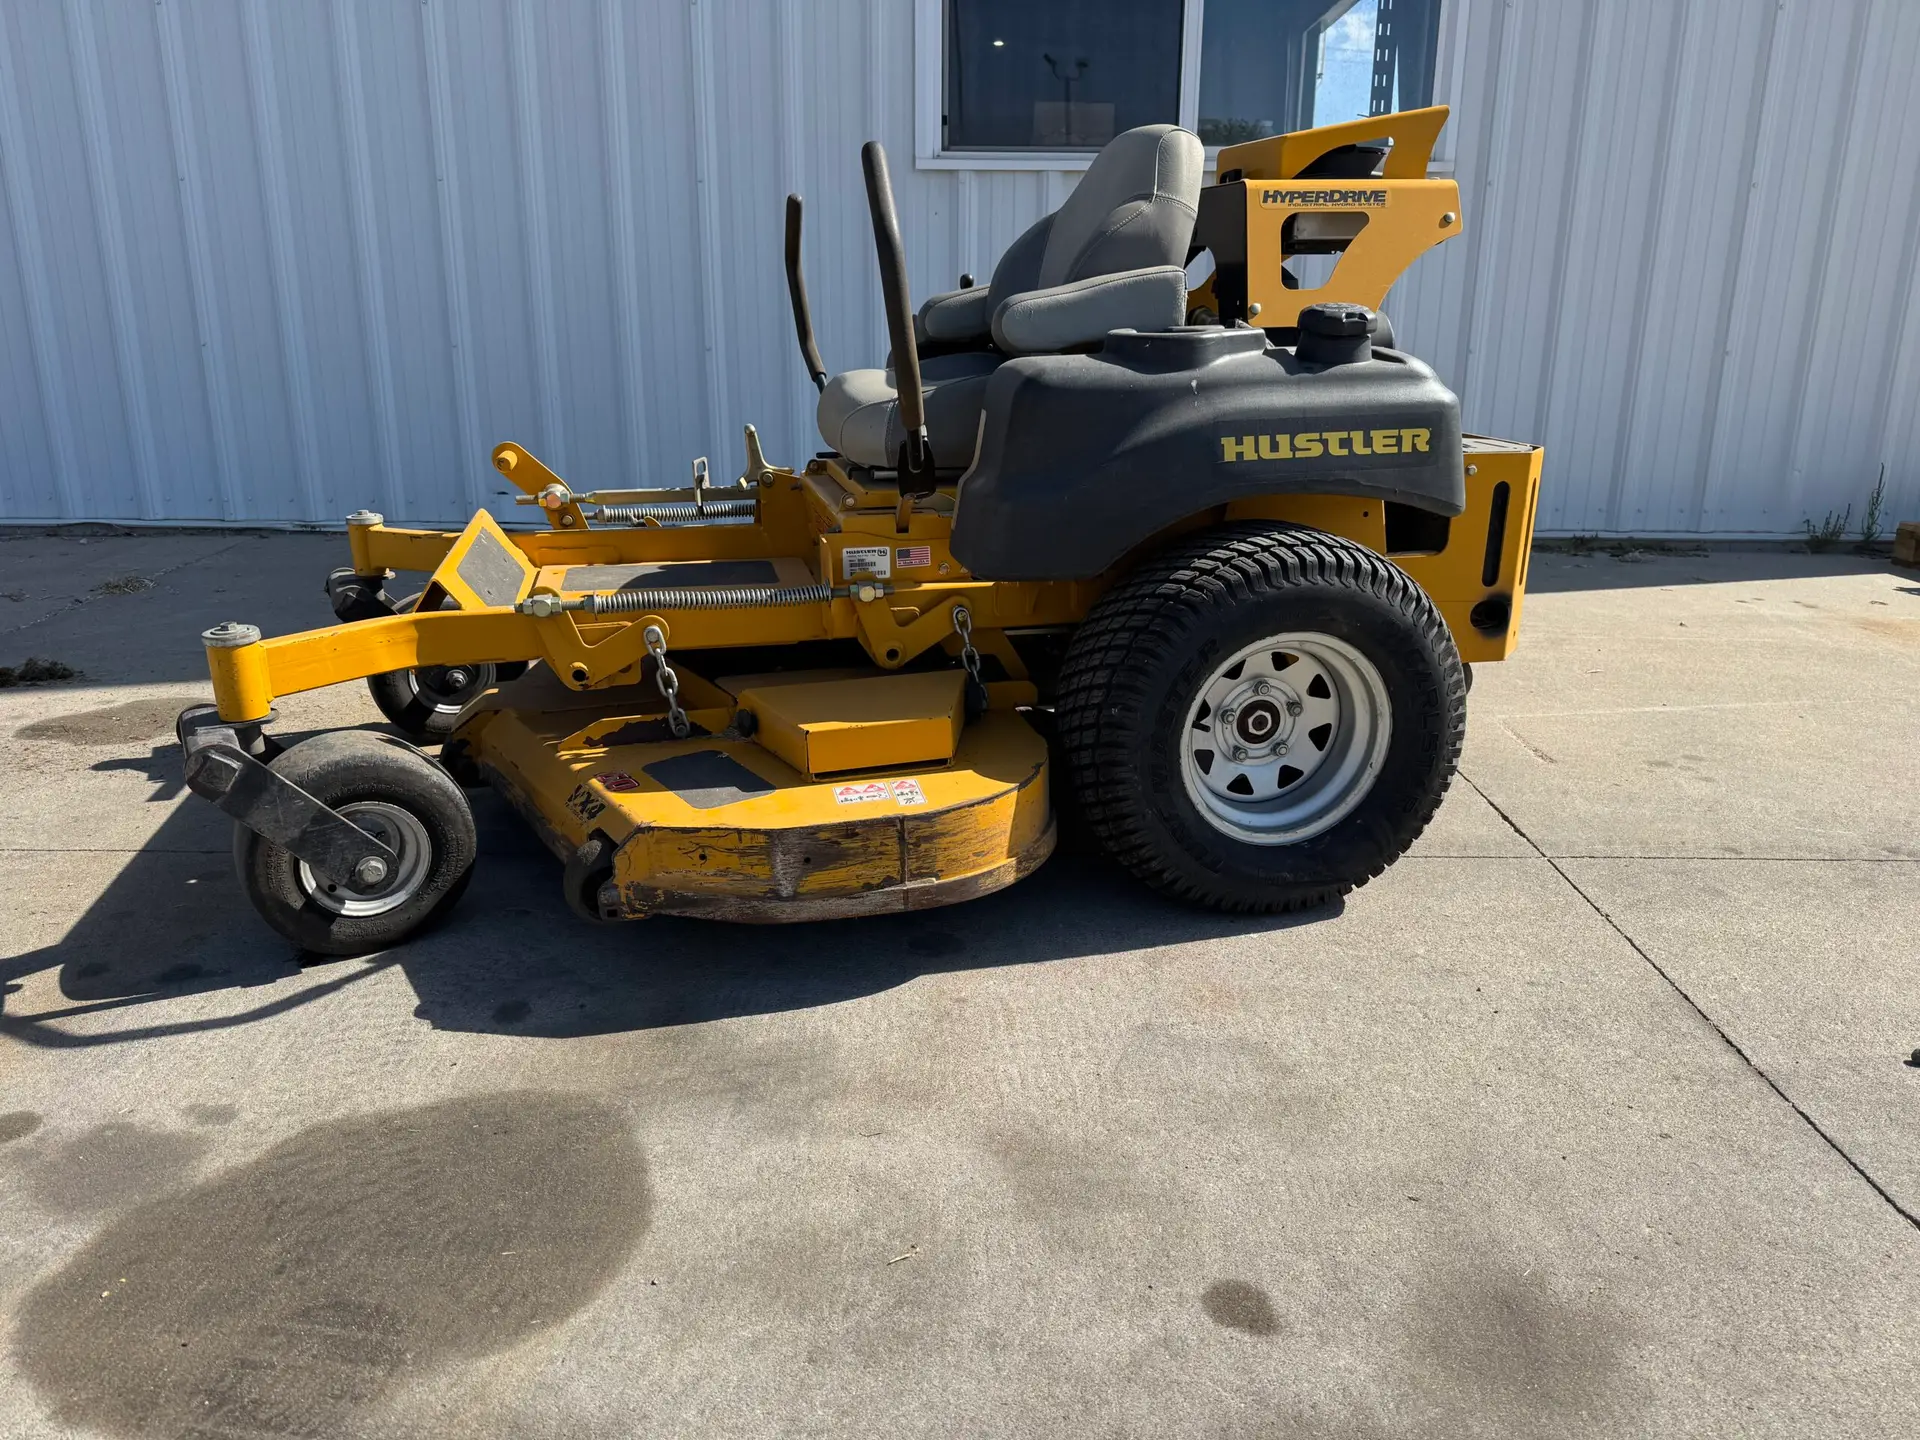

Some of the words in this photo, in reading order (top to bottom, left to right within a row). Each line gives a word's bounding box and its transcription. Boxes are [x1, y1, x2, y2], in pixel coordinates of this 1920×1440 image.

[1262, 190, 1387, 203] HYPERDRIVE
[1221, 428, 1431, 461] HUSTLER
[1149, 635, 1221, 796] MASTER
